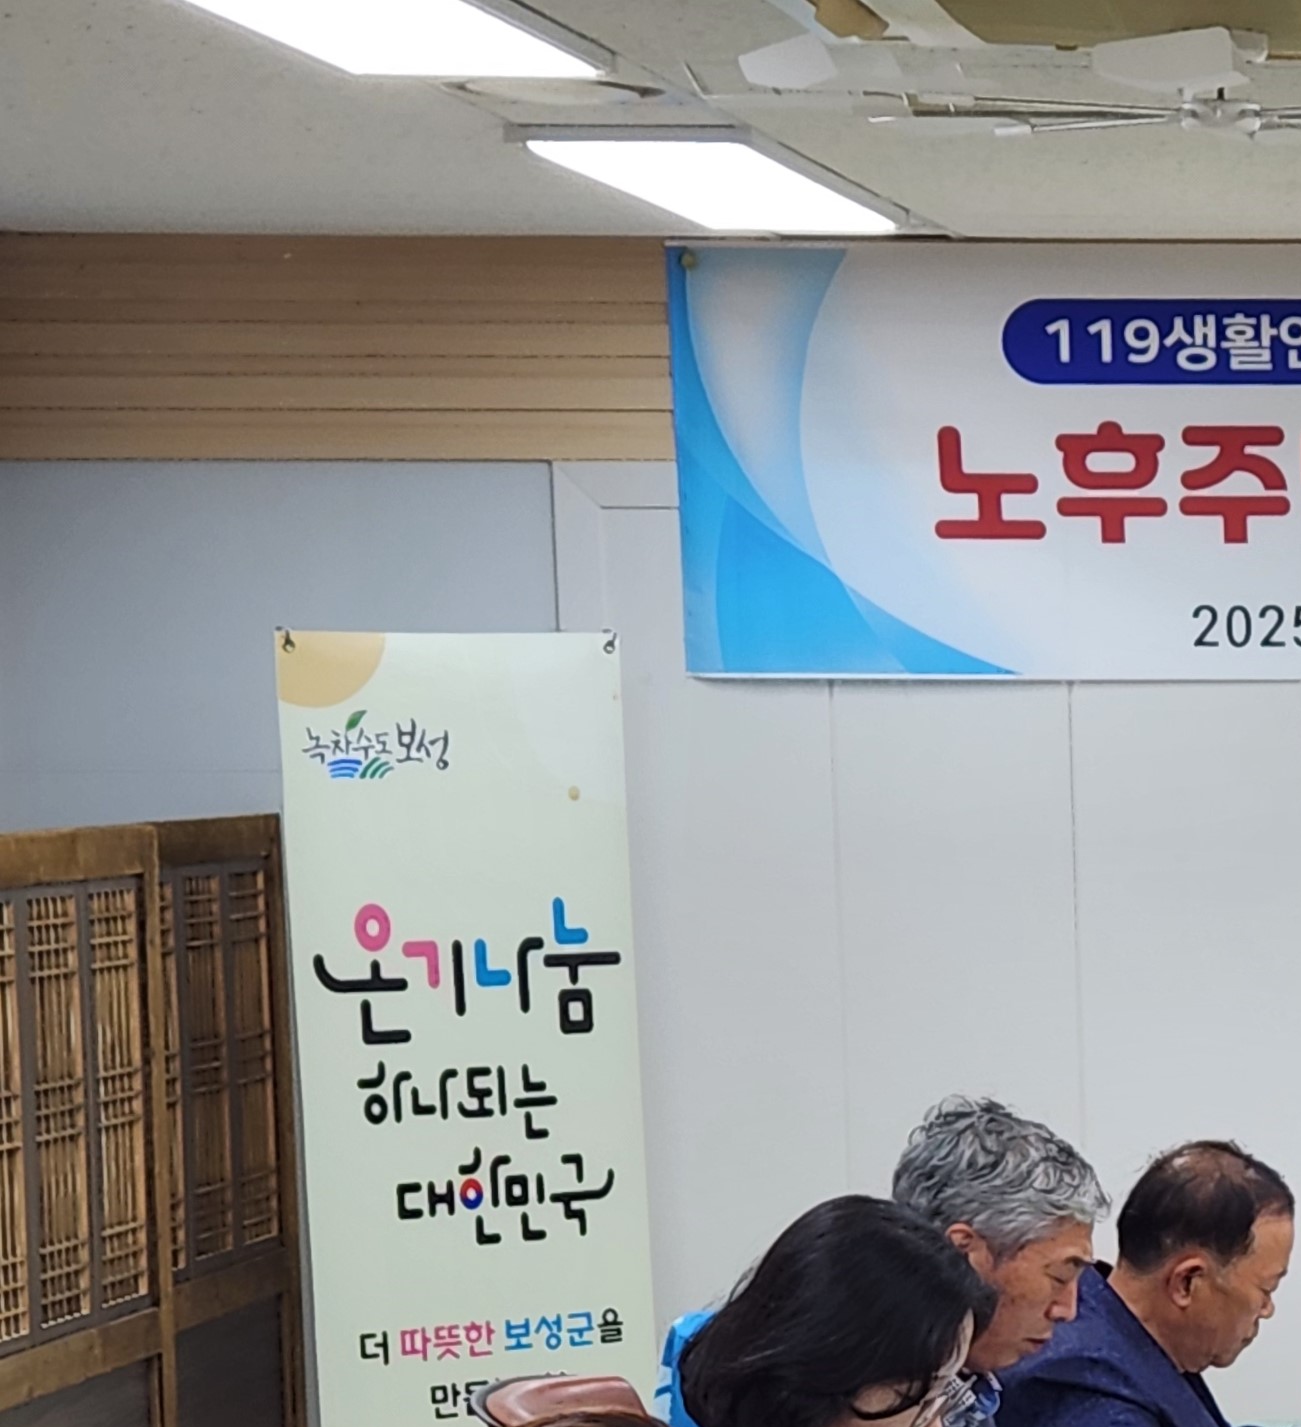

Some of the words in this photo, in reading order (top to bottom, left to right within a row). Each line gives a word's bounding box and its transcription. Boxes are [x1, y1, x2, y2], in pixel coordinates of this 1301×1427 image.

[301, 726, 393, 765] 녹차수도
[395, 718, 450, 771] 보성
[312, 895, 623, 1047] 온기나눔
[357, 1061, 560, 1140] 하나되는
[396, 1147, 617, 1246] 대한민국
[359, 1330, 391, 1366] 더
[400, 1319, 496, 1362] 따뜻한
[503, 1307, 624, 1352] 보성군을
